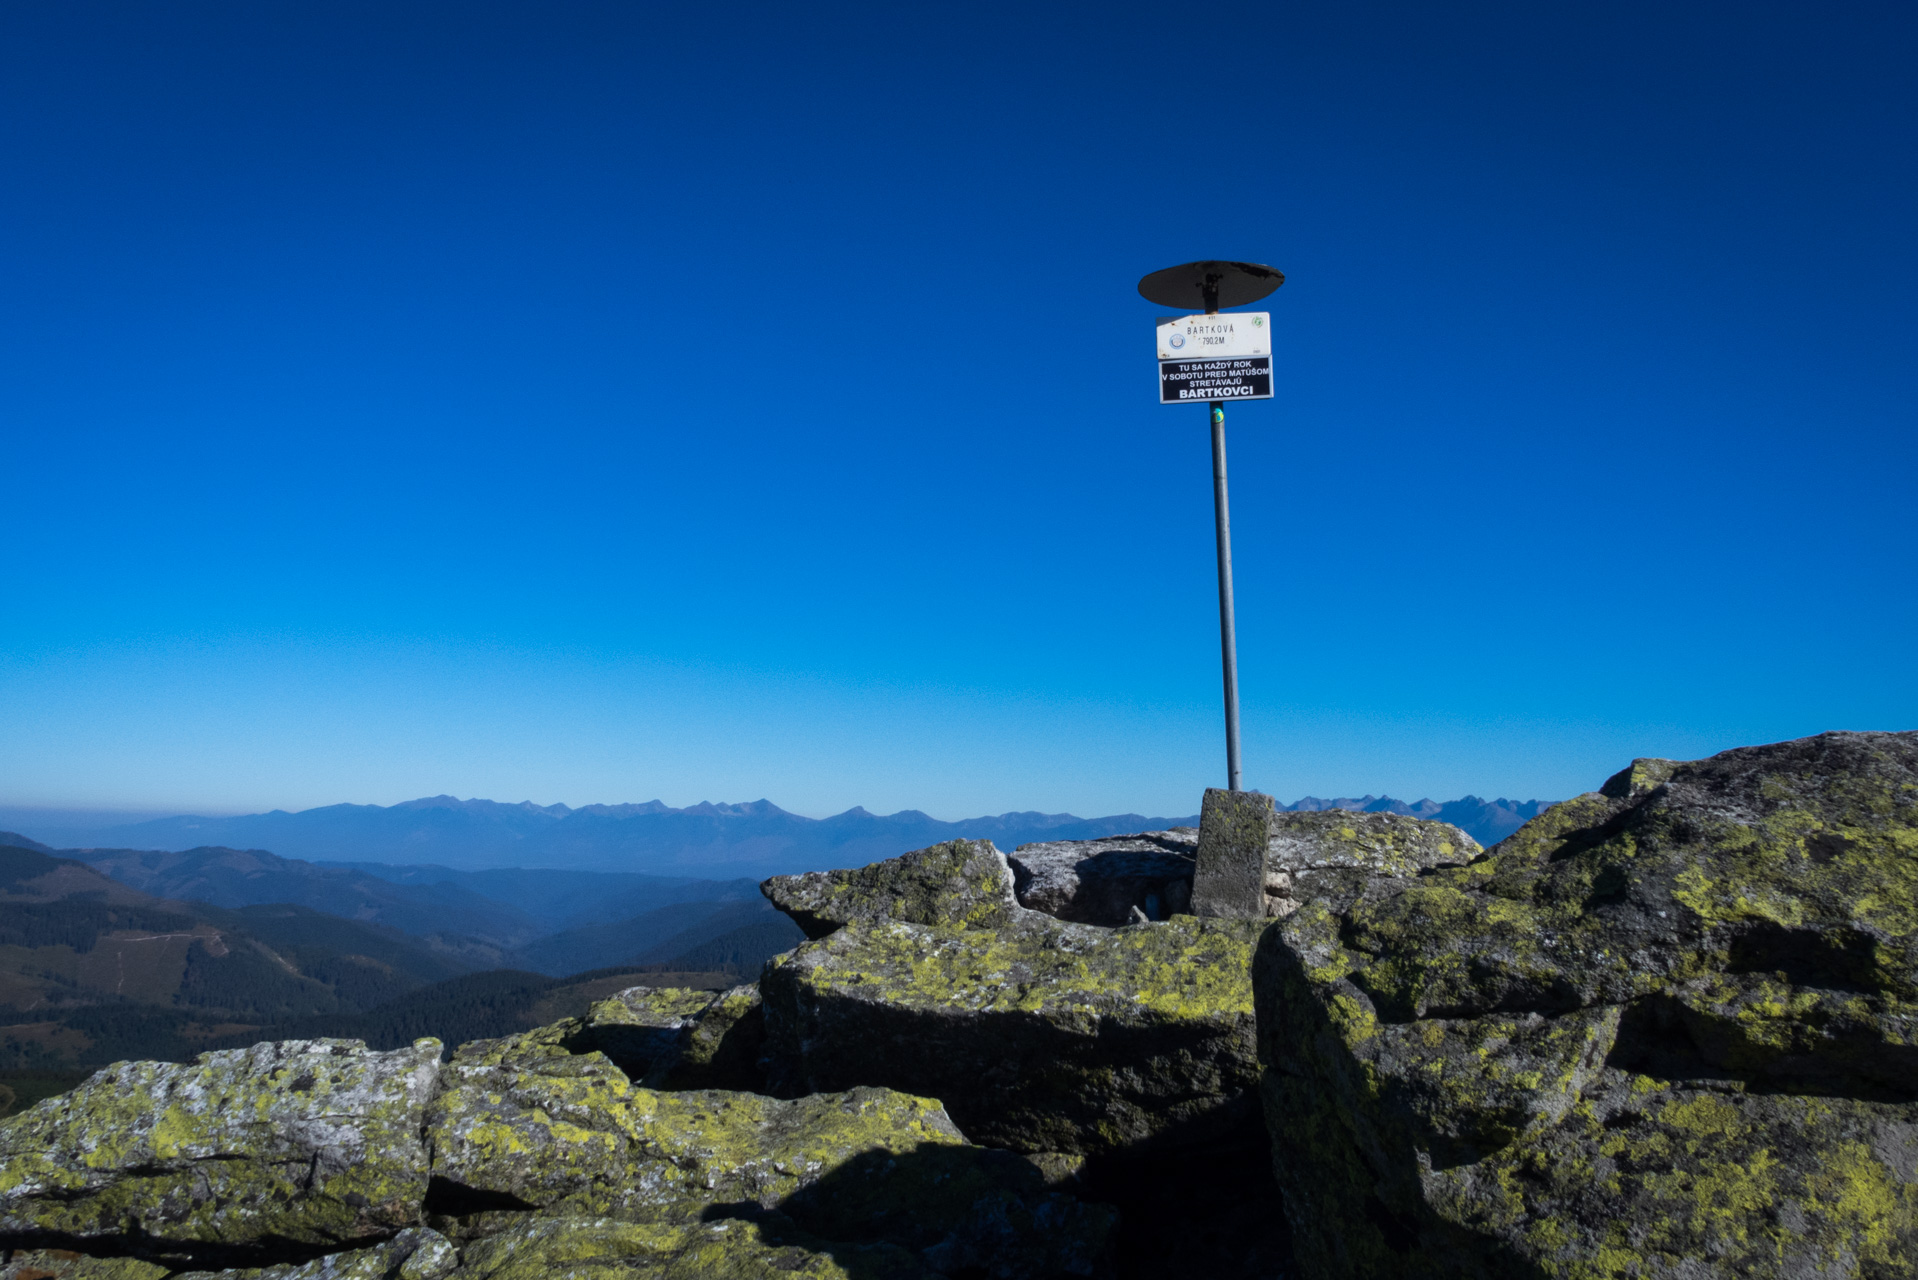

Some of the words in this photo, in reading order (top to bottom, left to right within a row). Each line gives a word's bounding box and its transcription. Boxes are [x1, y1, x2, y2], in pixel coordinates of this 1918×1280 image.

[1179, 364, 1190, 372] TU
[1191, 363, 1203, 371] SA
[1204, 361, 1232, 370] KAŽDÝ
[1233, 360, 1252, 368] ROK
[1169, 371, 1203, 380] SOBOTU
[1204, 370, 1227, 378] PRED
[1229, 367, 1269, 377] MATÚŠOM
[1189, 377, 1242, 387] STRETÁVAJÚ
[1179, 386, 1253, 398] BARTKOVCI
